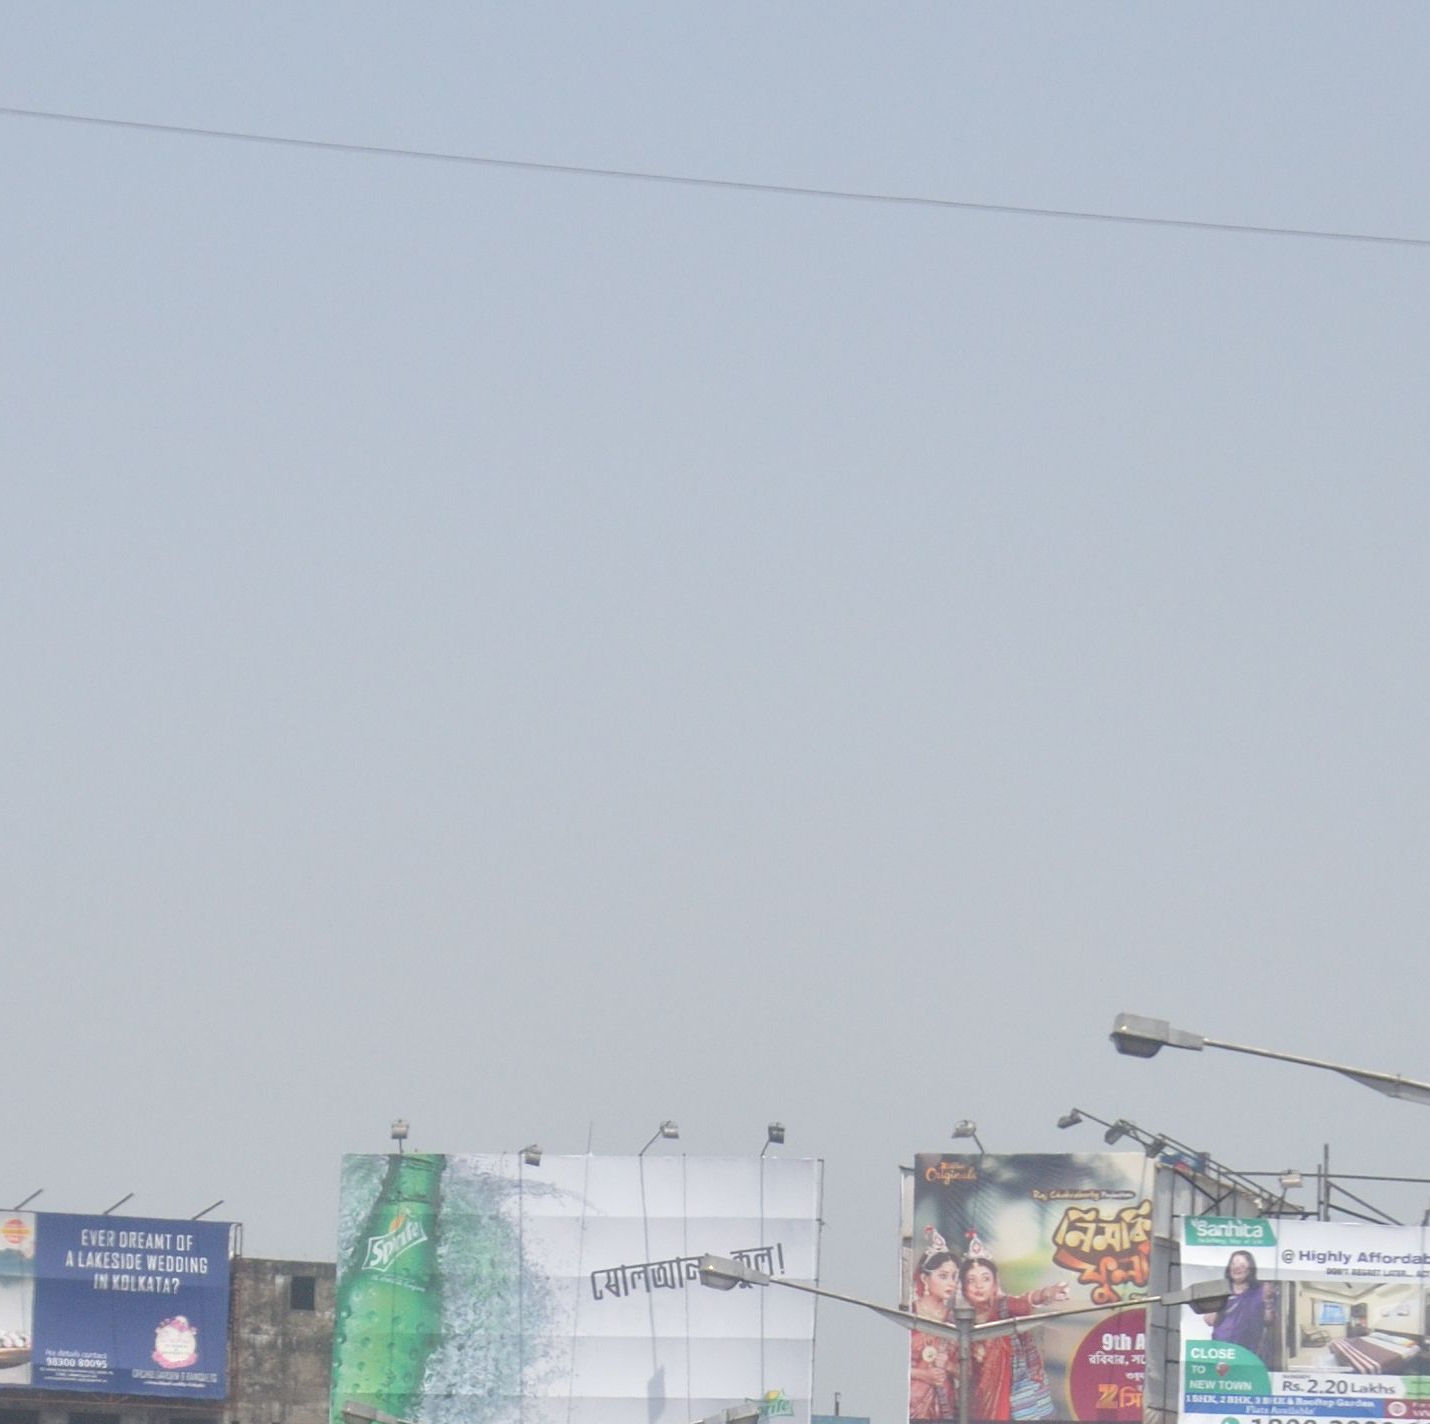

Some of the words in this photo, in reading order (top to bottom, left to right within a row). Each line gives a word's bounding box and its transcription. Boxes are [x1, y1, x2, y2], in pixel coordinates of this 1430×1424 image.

[1195, 1219, 1264, 1239] Sanhita
[81, 1228, 115, 1248] EVER
[119, 1231, 172, 1250] DREAMT
[176, 1234, 194, 1252] OF
[370, 1219, 421, 1267] Sprite
[65, 1250, 74, 1267] A
[78, 1252, 142, 1271] LAKESIDE
[146, 1255, 208, 1274] WEDDING
[1281, 1249, 1295, 1264] @
[1298, 1249, 1351, 1265] Highly
[94, 1274, 108, 1290] IN
[112, 1275, 181, 1294] KOLKATA?
[1101, 1333, 1131, 1351] 9th
[1190, 1347, 1237, 1360] CLOSE
[1191, 1365, 1207, 1374] TO
[1189, 1379, 1216, 1390] NEW
[1220, 1380, 1253, 1391] TOWN
[1307, 1379, 1349, 1395] 2.20
[1351, 1383, 1396, 1395] Lakhs
